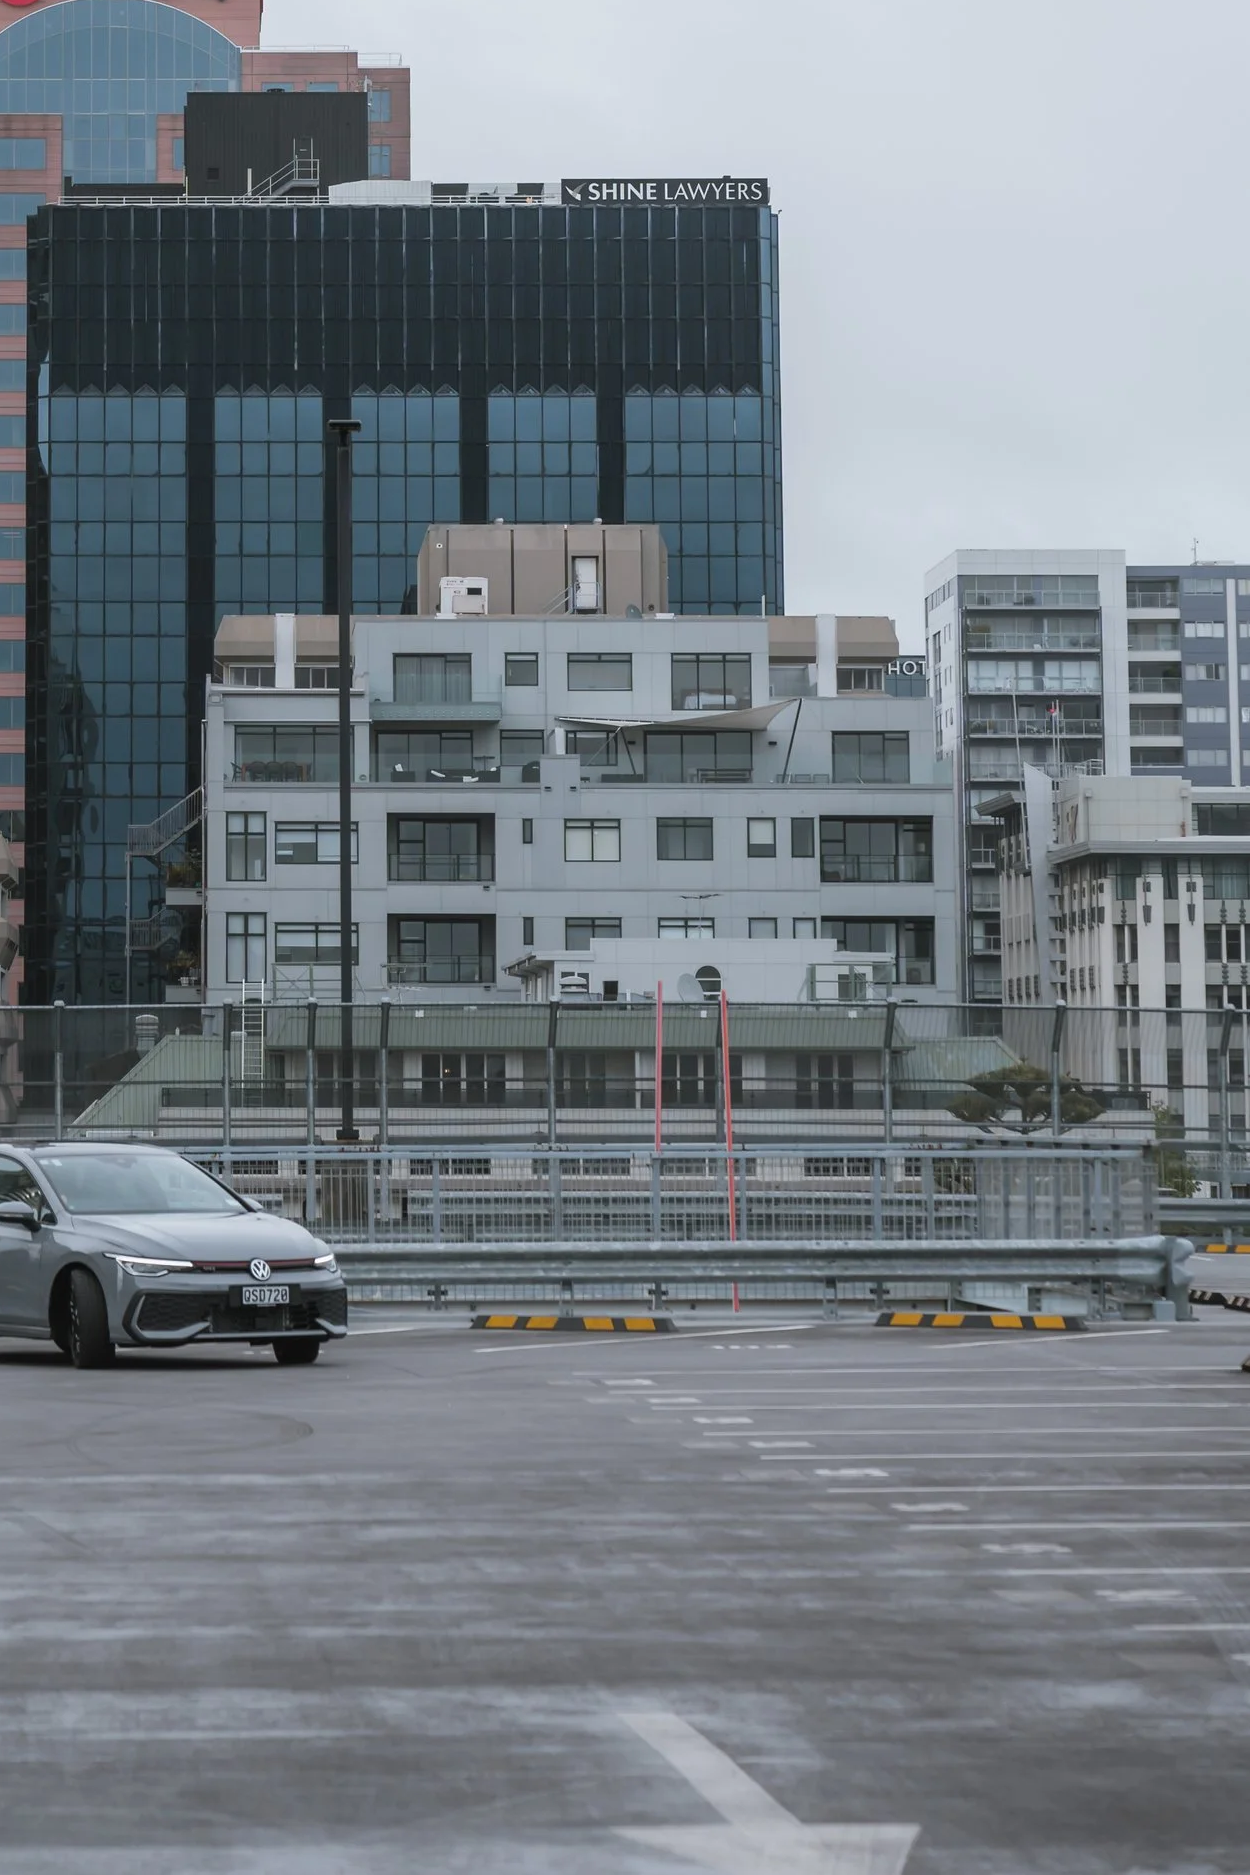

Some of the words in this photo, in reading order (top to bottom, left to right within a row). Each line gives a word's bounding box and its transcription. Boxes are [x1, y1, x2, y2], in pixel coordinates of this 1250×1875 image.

[588, 182, 658, 201] SHINE
[664, 182, 763, 201] LAWYERS
[244, 1288, 288, 1303] QSD720
